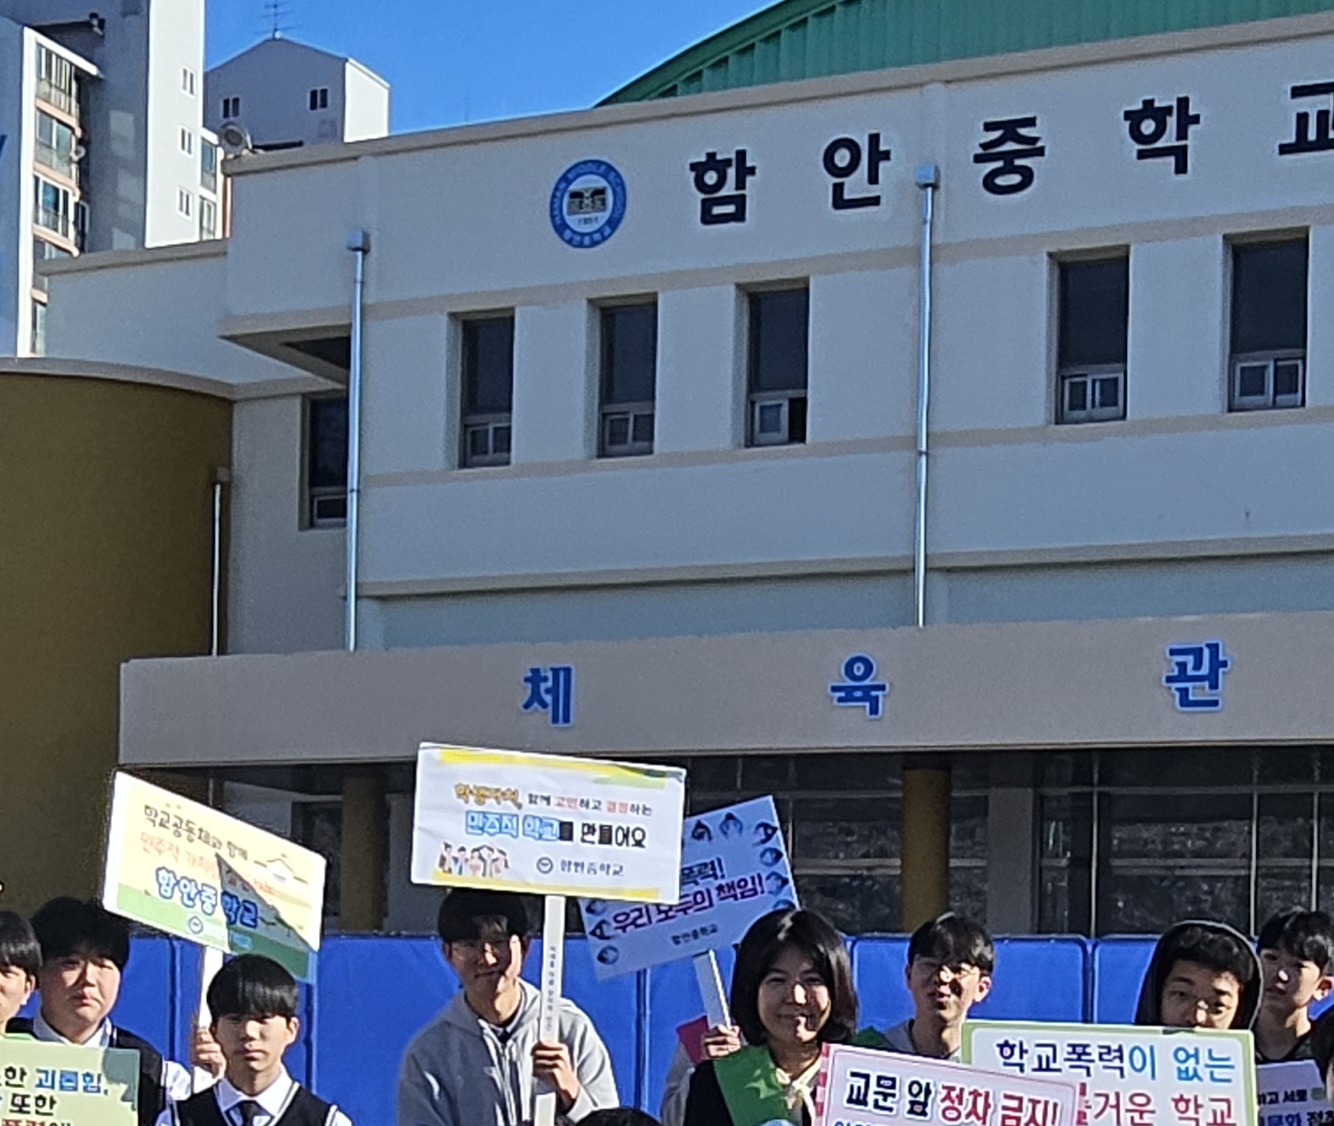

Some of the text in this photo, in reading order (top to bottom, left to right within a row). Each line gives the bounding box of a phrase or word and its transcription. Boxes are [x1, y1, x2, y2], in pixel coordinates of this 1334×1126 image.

[466, 811, 518, 837] 민주적
[580, 822, 647, 848] 만들어요
[612, 907, 653, 933] 우리
[716, 872, 766, 902] 책임!
[996, 1038, 1235, 1084] 학교폭력이 없는
[34, 1068, 109, 1096] 괴롭힘,
[846, 1070, 898, 1113] 교문
[906, 1079, 933, 1119] 앞
[9, 1093, 57, 1117] 또한
